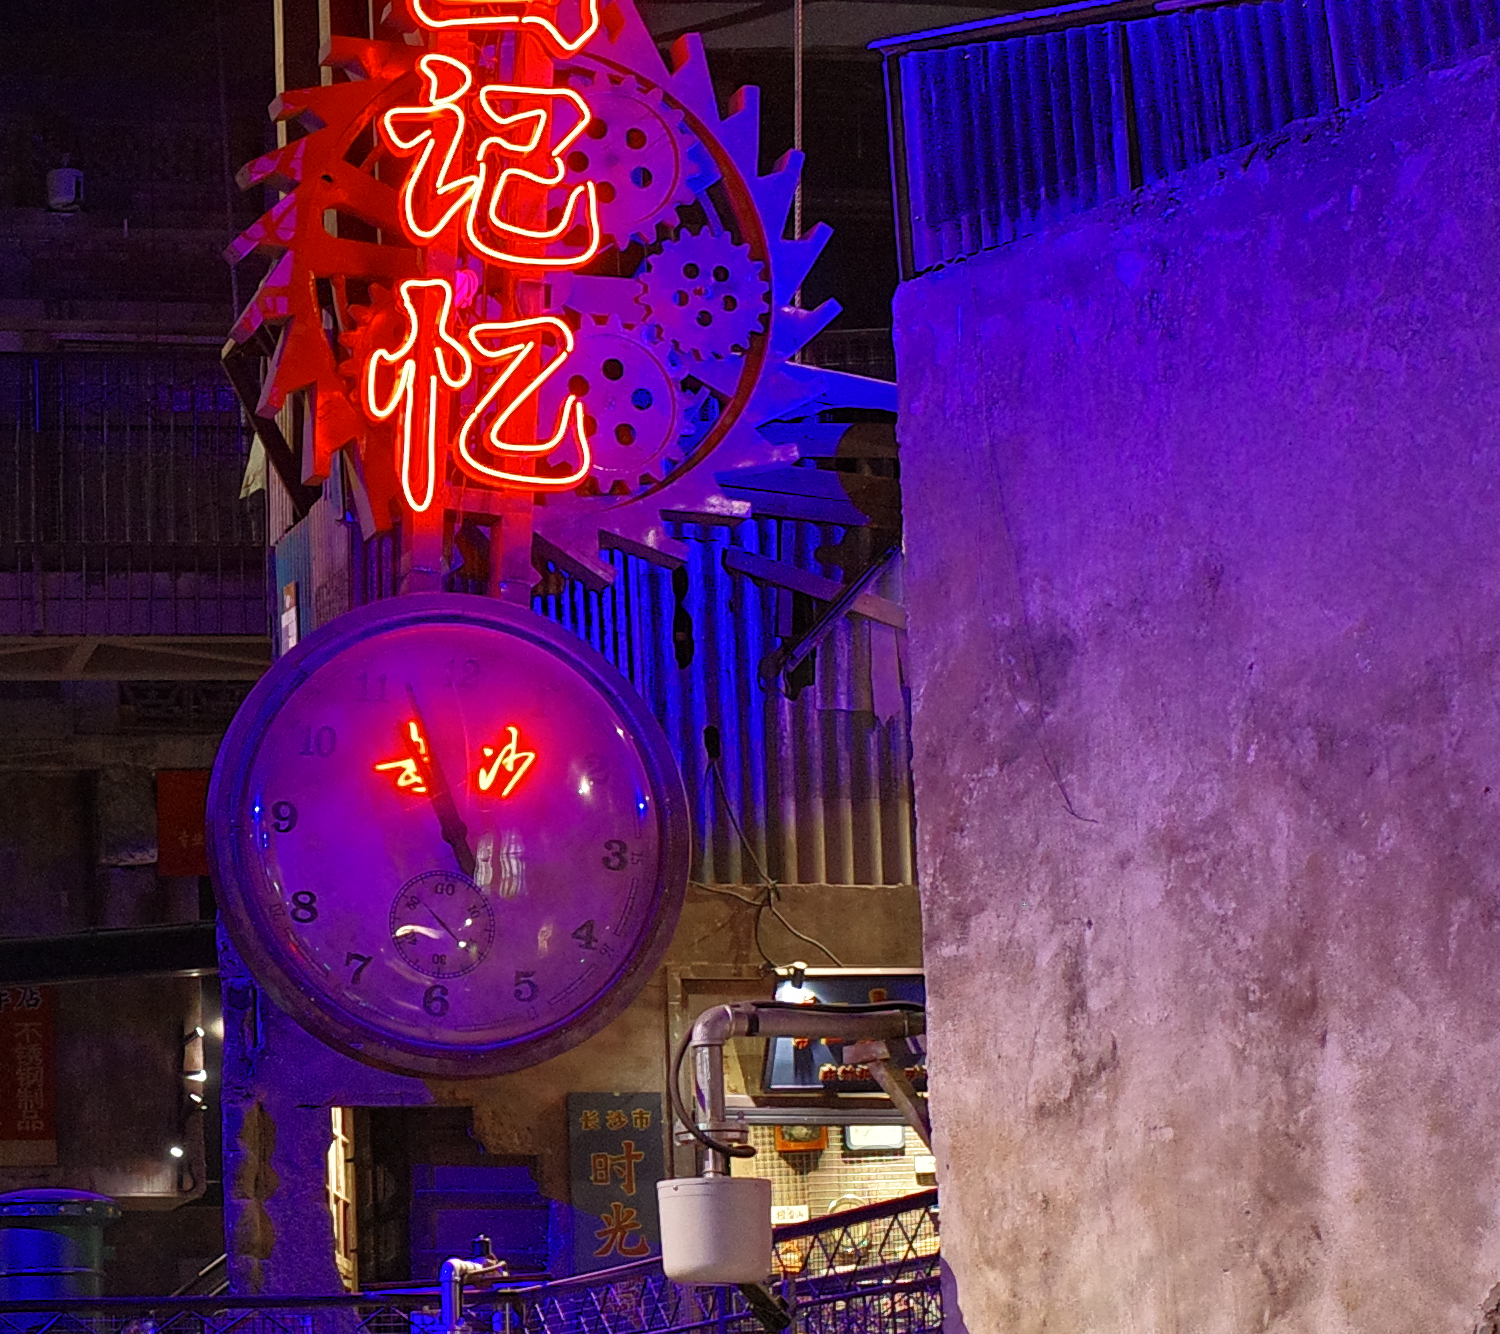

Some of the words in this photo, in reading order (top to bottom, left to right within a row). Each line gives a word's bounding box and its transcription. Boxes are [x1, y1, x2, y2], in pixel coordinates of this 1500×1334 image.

[271, 800, 298, 833] 9
[602, 839, 628, 872] 3
[290, 890, 319, 924] 8
[344, 953, 373, 985] 7
[422, 984, 450, 1017] 6
[514, 971, 539, 1002] 5
[579, 1108, 653, 1132] 长沙市
